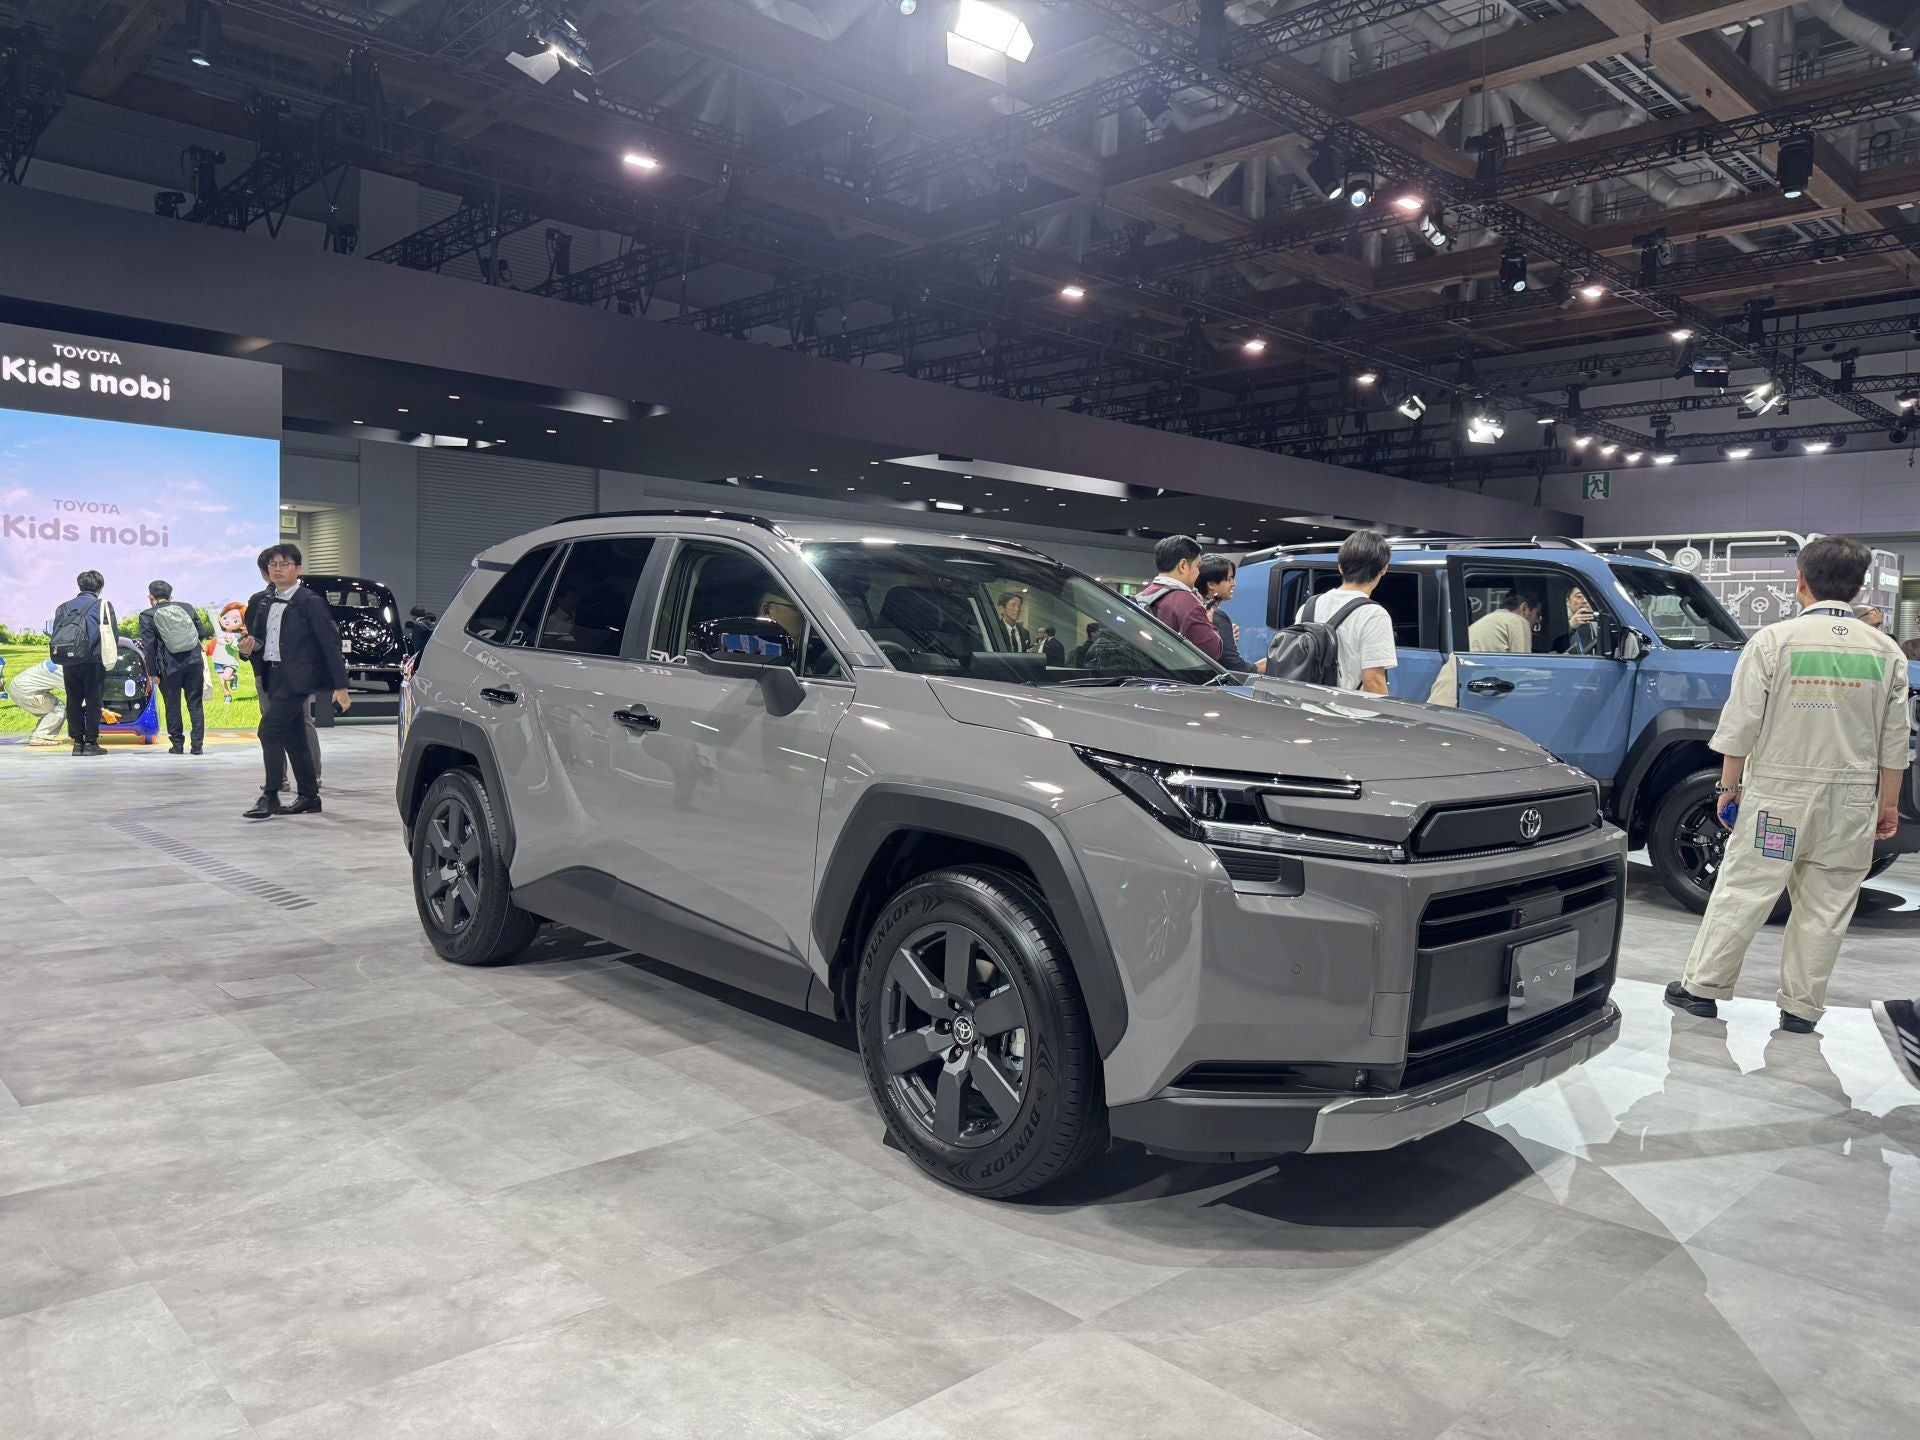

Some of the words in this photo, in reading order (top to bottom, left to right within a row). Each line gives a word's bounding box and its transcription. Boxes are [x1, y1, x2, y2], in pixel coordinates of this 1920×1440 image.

[53, 344, 121, 365] TOYOTA
[2, 356, 81, 390] Kids
[90, 375, 171, 401] mobi
[53, 499, 120, 515] TOYOTA
[3, 514, 79, 542] Kids
[90, 524, 169, 548] mobi
[865, 901, 913, 971] DUNLOP
[1516, 963, 1572, 989] RAV4
[981, 1104, 1040, 1177] DUNLOP
